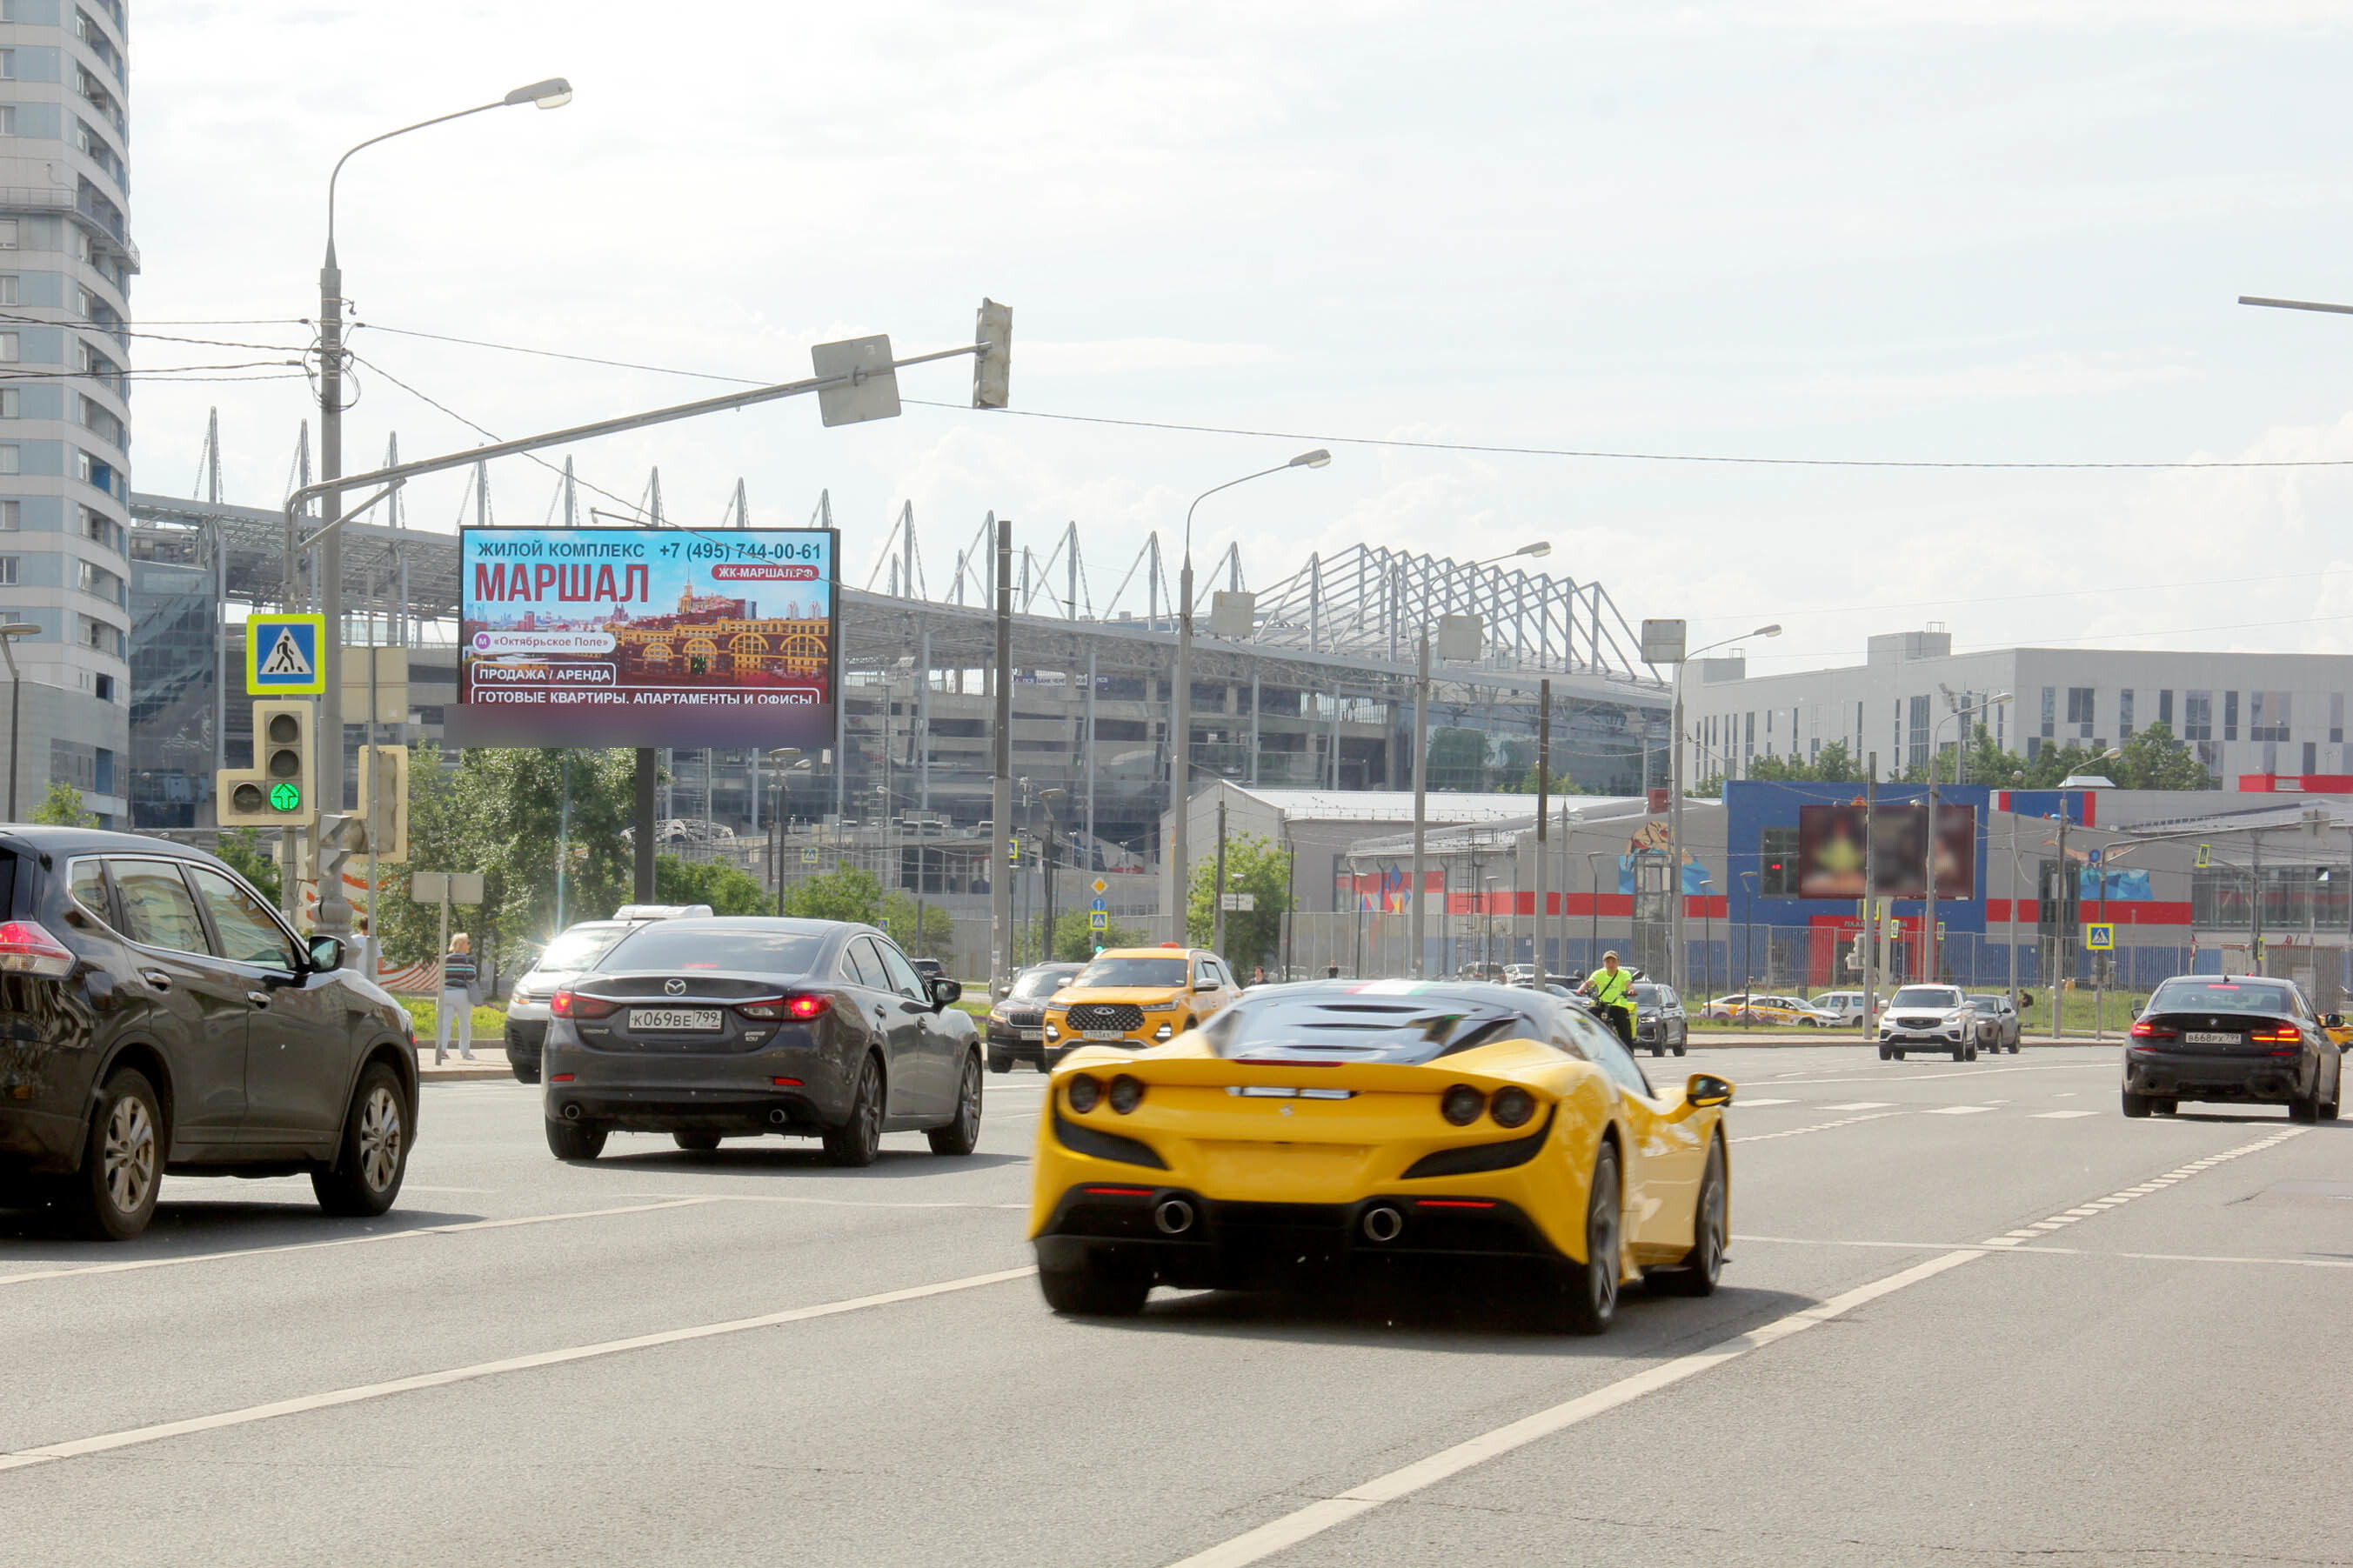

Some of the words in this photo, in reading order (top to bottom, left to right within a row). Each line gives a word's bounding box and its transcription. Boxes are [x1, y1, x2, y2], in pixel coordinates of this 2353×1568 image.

[478, 540, 542, 557] ЖИЛОЙ
[549, 543, 645, 557] КОМПЛЕКС
[660, 543, 680, 558] +7
[686, 543, 730, 561] (495)
[736, 543, 820, 559] 744-00-61
[719, 567, 814, 579] ЖК-МАРШАЛ.РФ
[475, 564, 648, 602] МАРШАЛ
[494, 635, 571, 648] «Октябрьское
[574, 636, 608, 647] Поле»
[479, 668, 546, 681] ПРОДАЖА
[557, 668, 611, 681] АРЕНДА
[478, 691, 547, 704] ГОТОВЫЕ
[634, 692, 739, 704] АПАРТАМЕНТЫ
[744, 693, 753, 704] И
[758, 693, 812, 704] ОФИСЫ
[634, 1011, 692, 1027] К069ВЕ
[696, 1012, 717, 1024] 799
